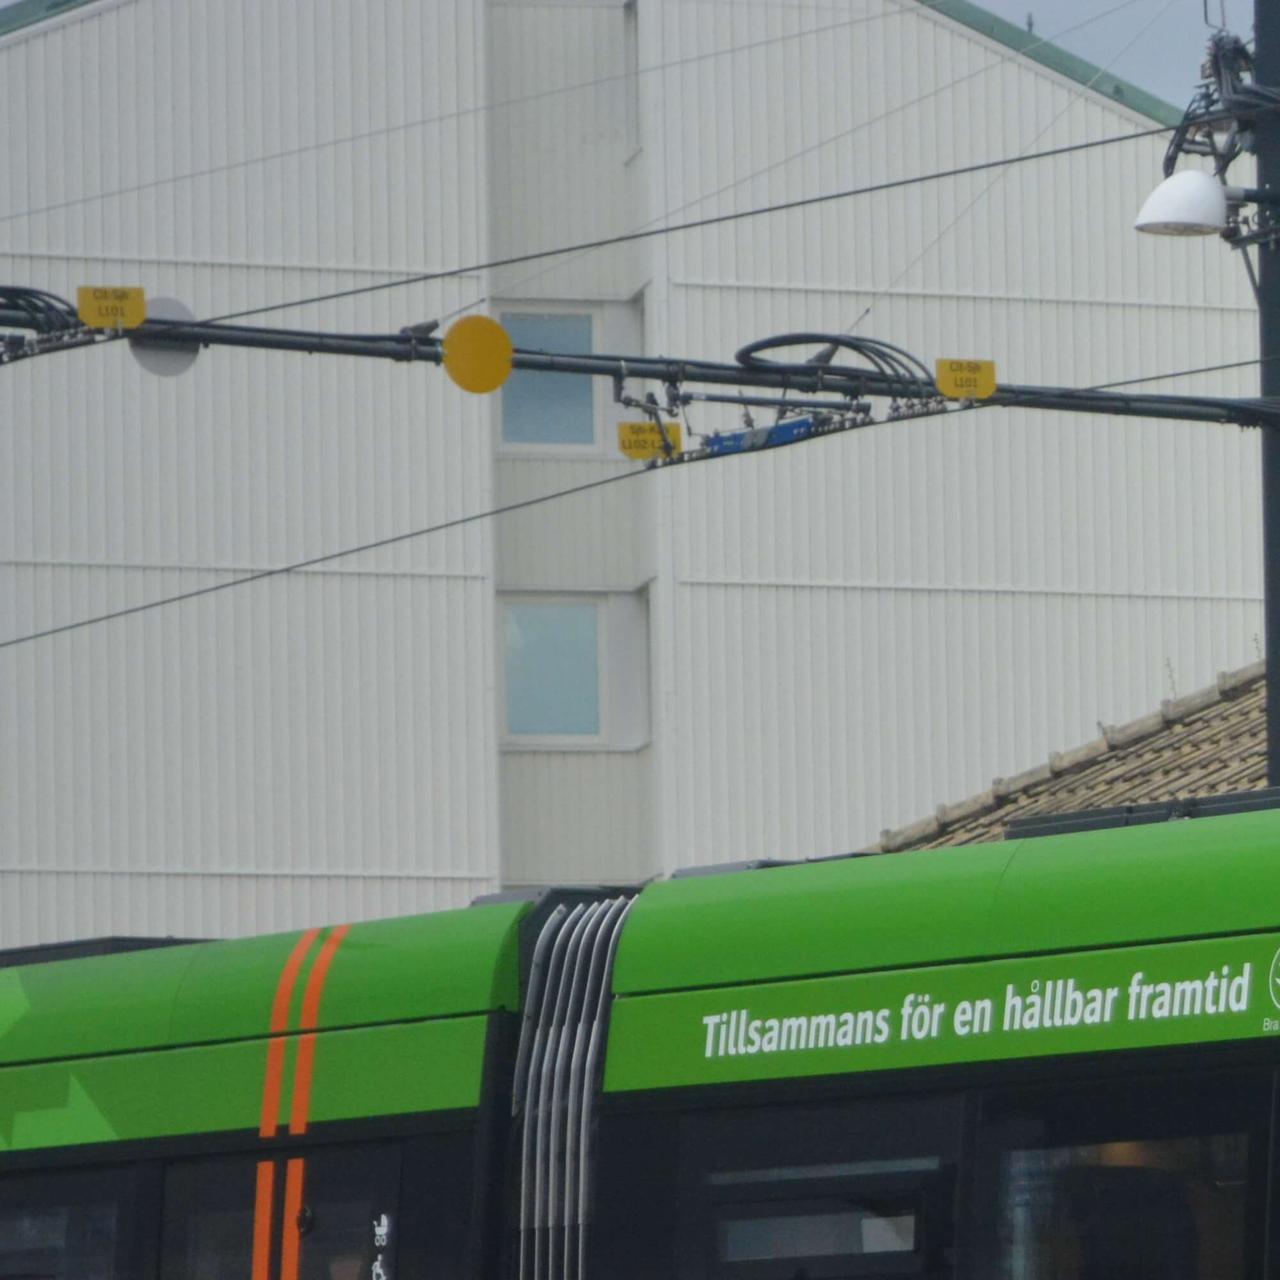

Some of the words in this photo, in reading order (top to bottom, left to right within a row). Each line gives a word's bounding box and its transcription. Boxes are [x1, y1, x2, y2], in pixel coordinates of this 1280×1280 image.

[702, 1008, 890, 1059] Tillsammans
[900, 992, 944, 1041] för
[952, 998, 993, 1038] en
[1002, 978, 1118, 1031] hållbar
[1127, 962, 1253, 1022] framtid
